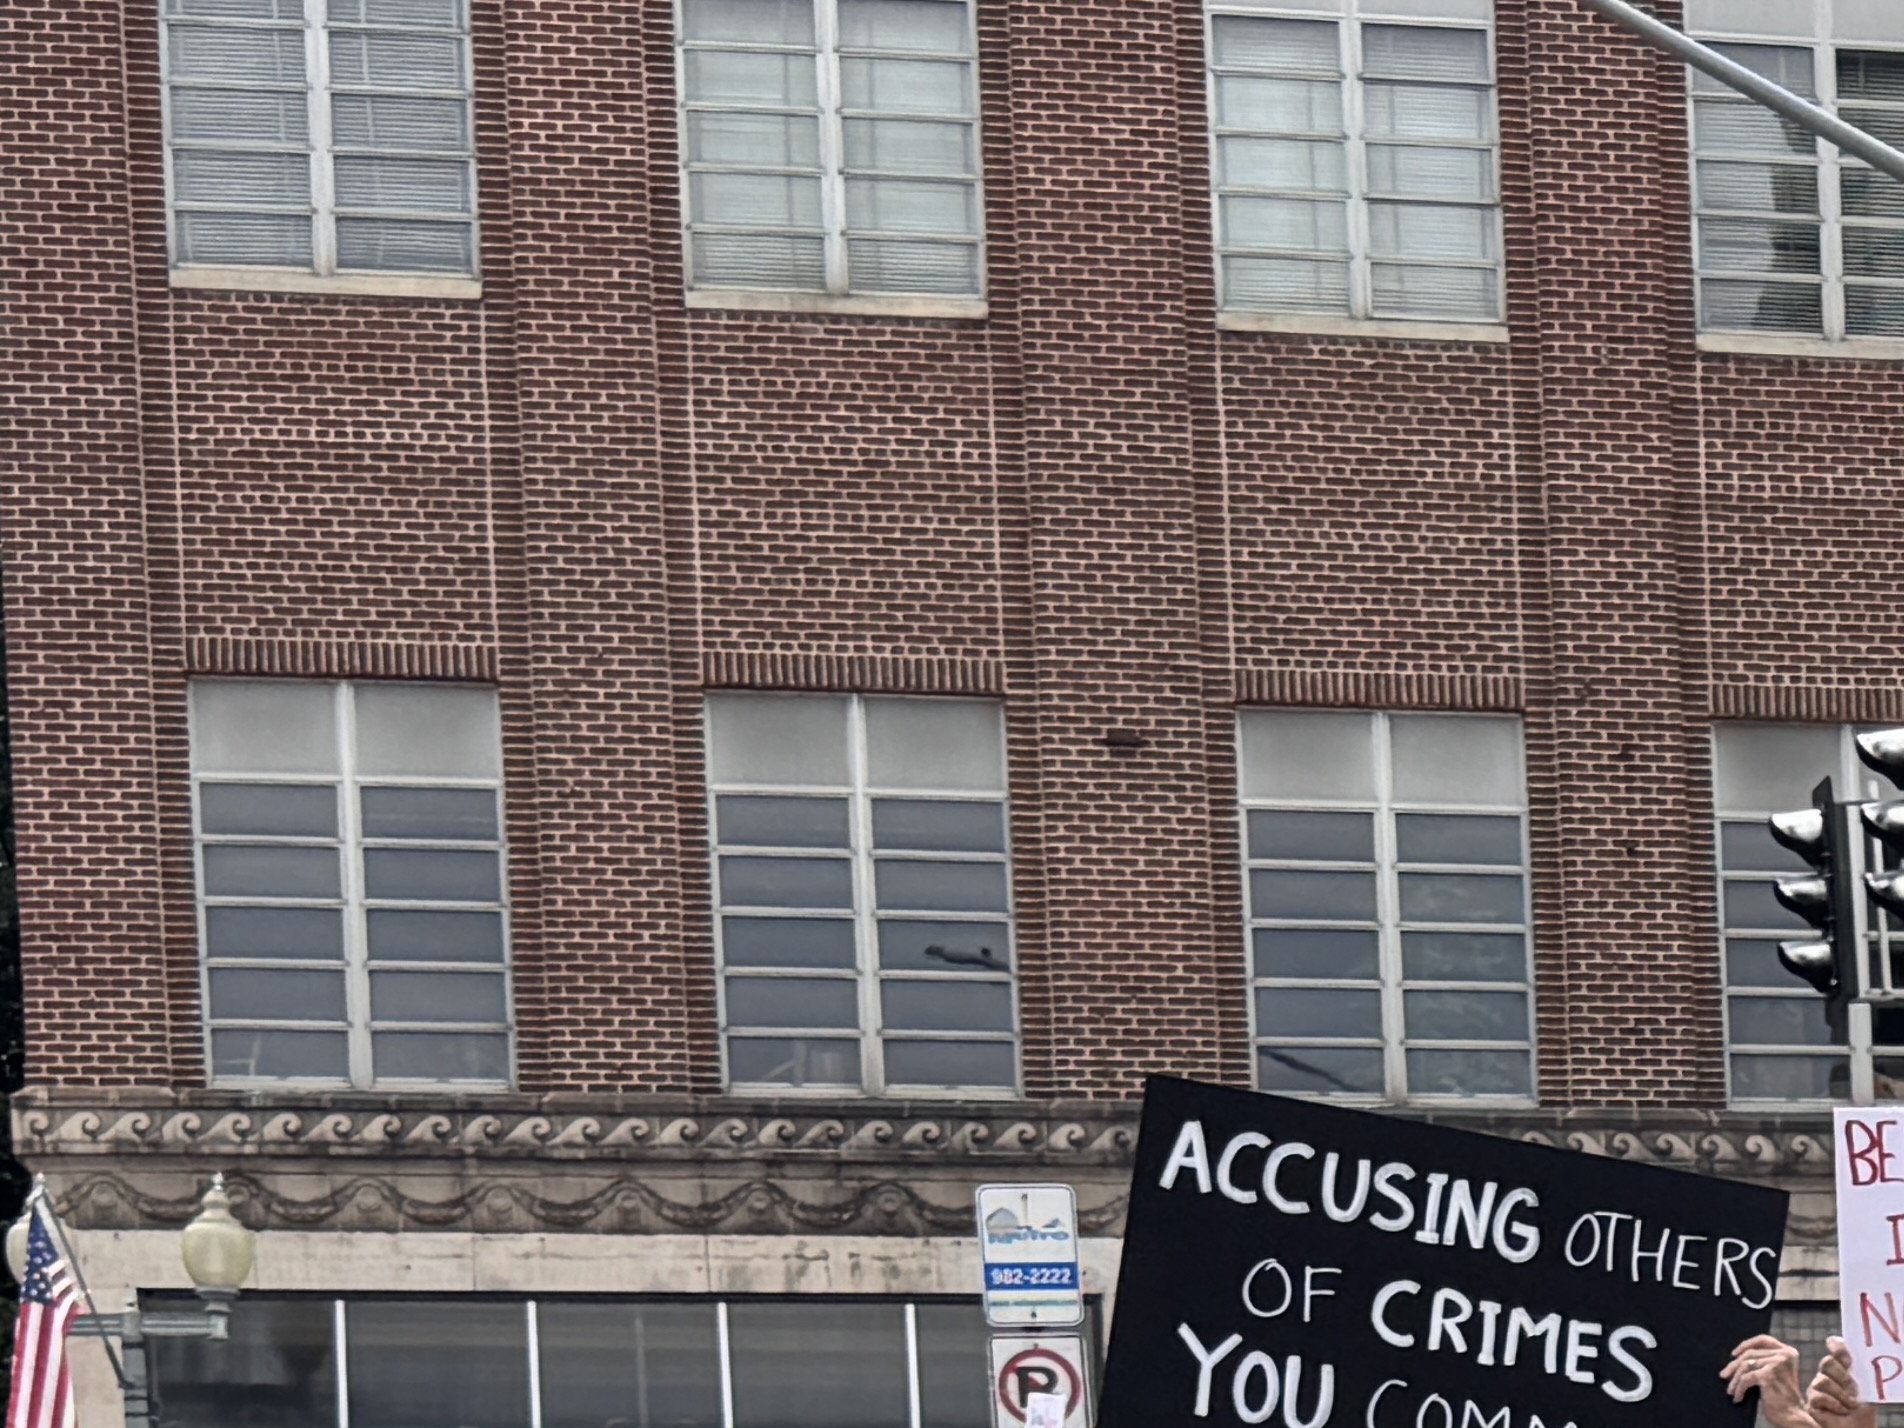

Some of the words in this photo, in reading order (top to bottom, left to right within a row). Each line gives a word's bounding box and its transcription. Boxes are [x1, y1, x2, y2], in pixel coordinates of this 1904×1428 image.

[1159, 1119, 1541, 1263] ACCUSING
[1564, 1210, 1776, 1310] OTHERS
[1241, 1258, 1342, 1322] OF
[1371, 1279, 1658, 1402] CRIMES
